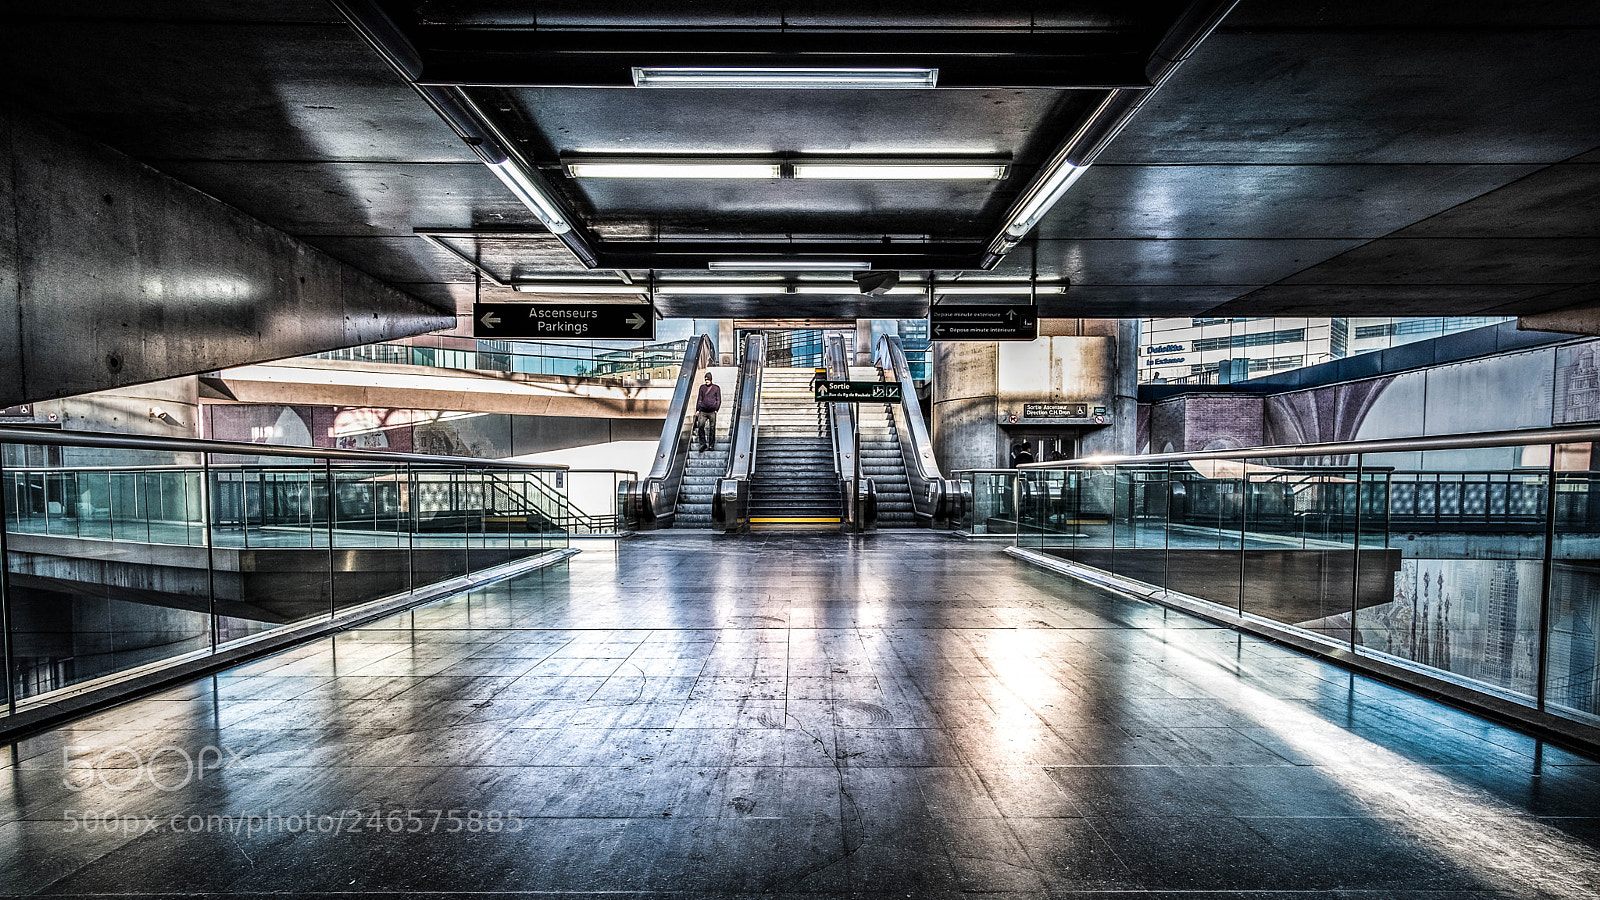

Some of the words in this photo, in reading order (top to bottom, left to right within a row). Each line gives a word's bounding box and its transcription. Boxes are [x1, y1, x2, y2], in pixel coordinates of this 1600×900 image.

[529, 307, 598, 319] Ascenseurs
[537, 321, 589, 335] Parkings
[828, 382, 850, 390] Sortie
